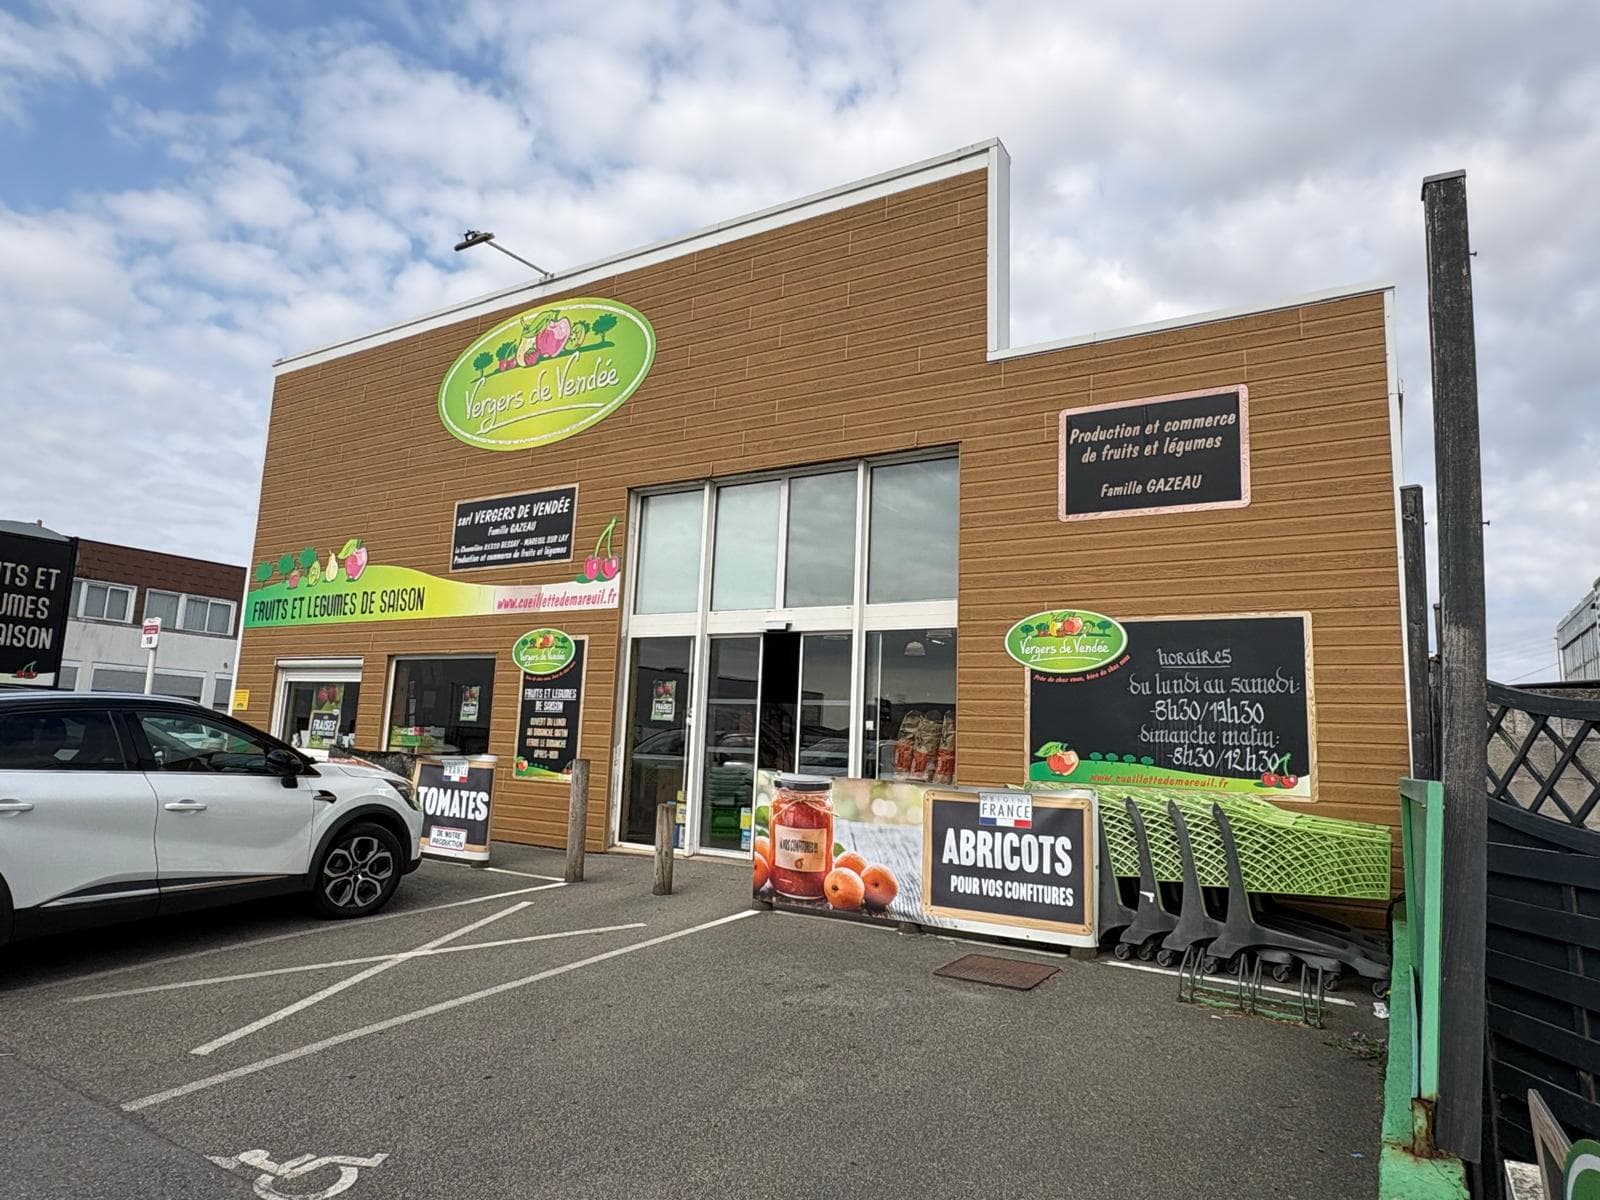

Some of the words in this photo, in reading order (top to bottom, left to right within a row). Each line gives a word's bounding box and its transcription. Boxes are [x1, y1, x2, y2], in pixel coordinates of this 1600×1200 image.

[465, 377, 525, 430] Vergers
[529, 369, 552, 405] de
[556, 351, 621, 399] Vendée
[1069, 424, 1140, 445] Production
[1145, 419, 1160, 435] et
[1164, 412, 1236, 433] commerce
[1081, 446, 1096, 463] de
[1101, 444, 1139, 462] fruits
[1144, 440, 1159, 456] et
[1163, 435, 1223, 458] légumes
[1100, 481, 1143, 498] Famille
[1146, 474, 1203, 494] GAZEAU
[457, 512, 473, 526] sarl
[474, 505, 516, 524] VERGERS
[517, 504, 530, 519] DE
[532, 496, 571, 517] VENDÉE
[488, 525, 509, 536] Famille
[509, 521, 537, 533] GAZEAU
[0, 561, 29, 587] TS
[34, 567, 61, 591] ET
[252, 599, 289, 622] FRUITS
[291, 597, 305, 620] ET
[307, 592, 357, 618] LEGUMES
[360, 591, 376, 614] DE
[379, 586, 426, 613] SAISON
[497, 588, 617, 610] www.cueillettedemareuil.fr
[1019, 635, 1057, 660] Vergers
[1060, 637, 1073, 653] de
[1074, 634, 1110, 653] Vendée
[1155, 672, 1201, 695] lundi
[1203, 679, 1227, 694] au
[313, 719, 337, 731] FRAISES
[1140, 724, 1217, 745] dimanche
[418, 786, 490, 821] TOMATES
[981, 795, 1030, 804] ORIGINE
[982, 803, 1031, 818] FRANCE
[432, 837, 463, 848] PRODUCTION
[942, 827, 1073, 877] ABRICOTS
[950, 875, 980, 895] POUR
[981, 878, 1003, 898] VOS
[1004, 881, 1074, 907] CONFITURES
